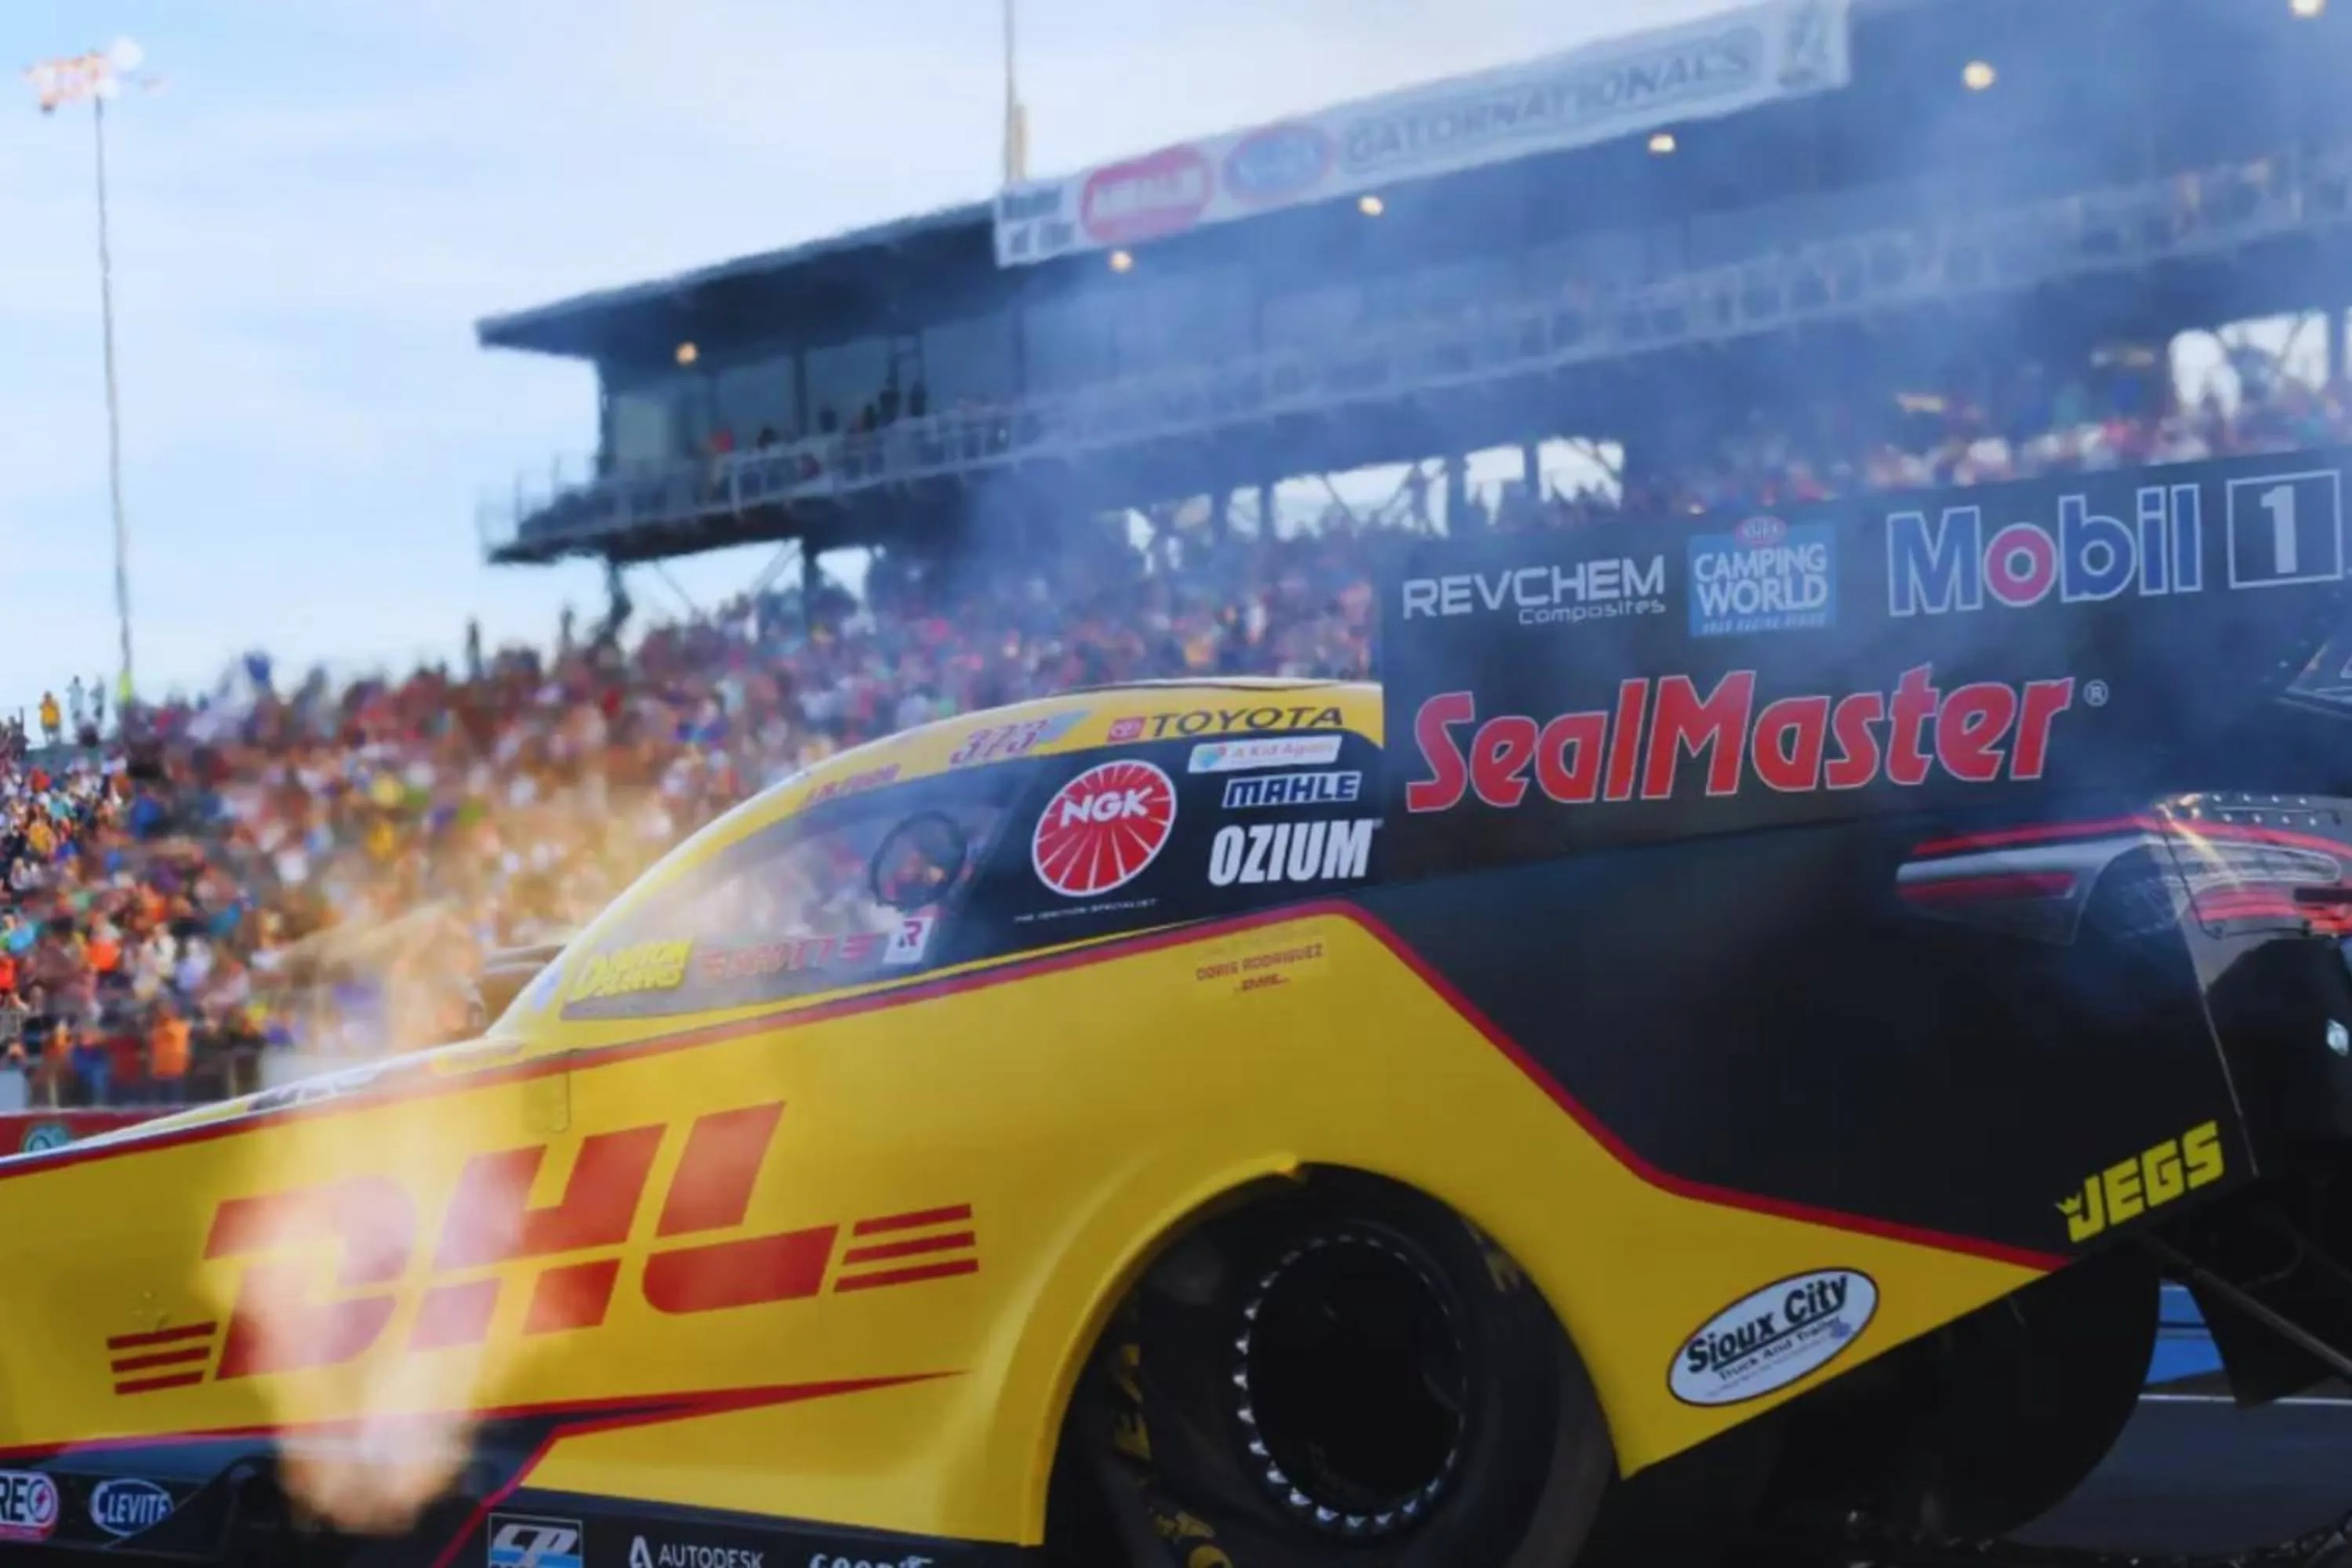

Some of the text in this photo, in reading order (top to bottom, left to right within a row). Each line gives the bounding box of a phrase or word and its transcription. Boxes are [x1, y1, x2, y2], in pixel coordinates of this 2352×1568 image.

[1693, 542, 1828, 583] CAMPING
[1886, 482, 2297, 617] Mobil 1
[1403, 554, 1665, 620] REVCHEM
[1696, 574, 1829, 617] WORLD
[1518, 598, 1667, 625] Composites
[1151, 707, 1343, 737] TOYOTA
[1059, 786, 1154, 829] NGK
[1224, 771, 1360, 808] MAHLE
[2067, 1120, 2225, 1243] JEGS
[203, 1101, 838, 1381] DHL
[1686, 1312, 1777, 1374] Sioux
[1783, 1274, 1848, 1325] City
